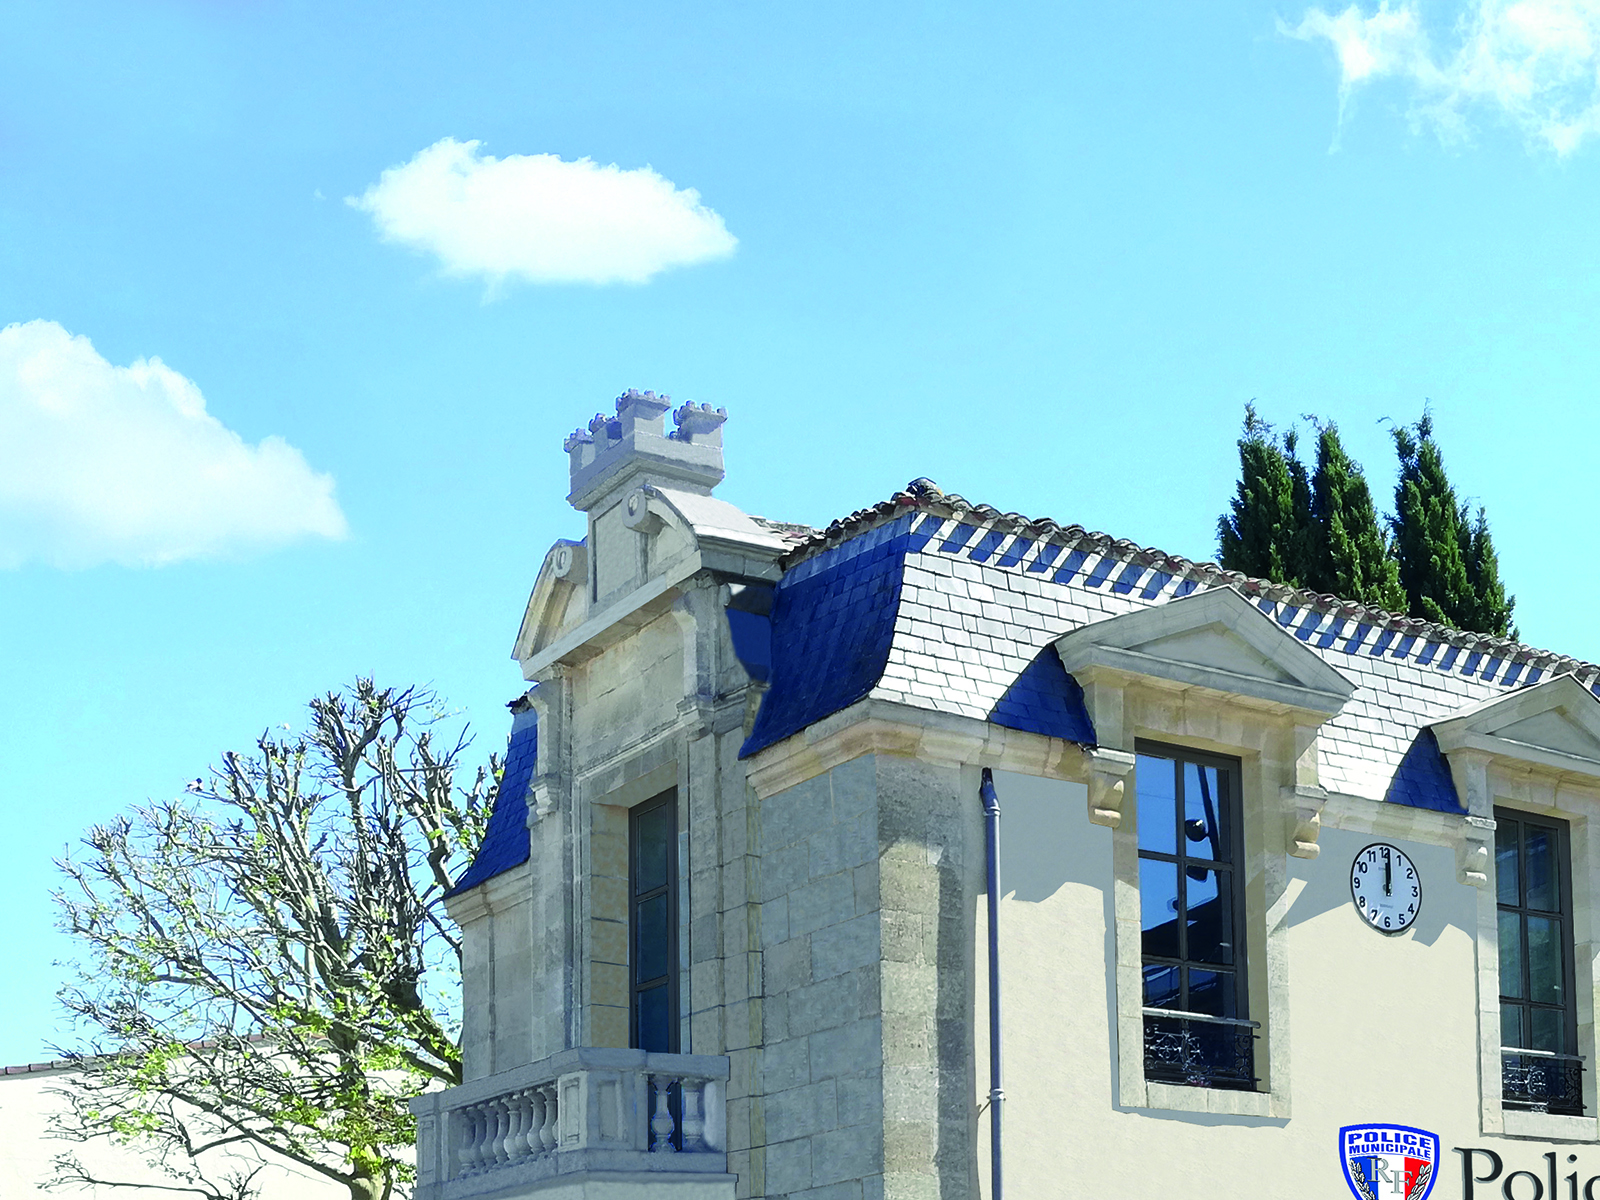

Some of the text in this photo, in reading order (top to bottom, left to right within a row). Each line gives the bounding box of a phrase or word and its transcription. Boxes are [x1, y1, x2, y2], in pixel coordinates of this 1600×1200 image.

[1366, 850, 1376, 863] 11
[1379, 847, 1391, 858] 12
[1396, 855, 1401, 866] 1
[1356, 861, 1368, 873] 10
[1406, 868, 1414, 879] 2
[1353, 877, 1360, 888] 9
[1411, 886, 1418, 897] 3
[1359, 896, 1365, 908] 8
[1407, 903, 1414, 914] 4
[1371, 909, 1378, 921] 7
[1398, 914, 1405, 925] 5
[1384, 916, 1391, 928] 6
[1348, 1131, 1431, 1150] POLICE
[1348, 1143, 1431, 1159] MUNICIPALE
